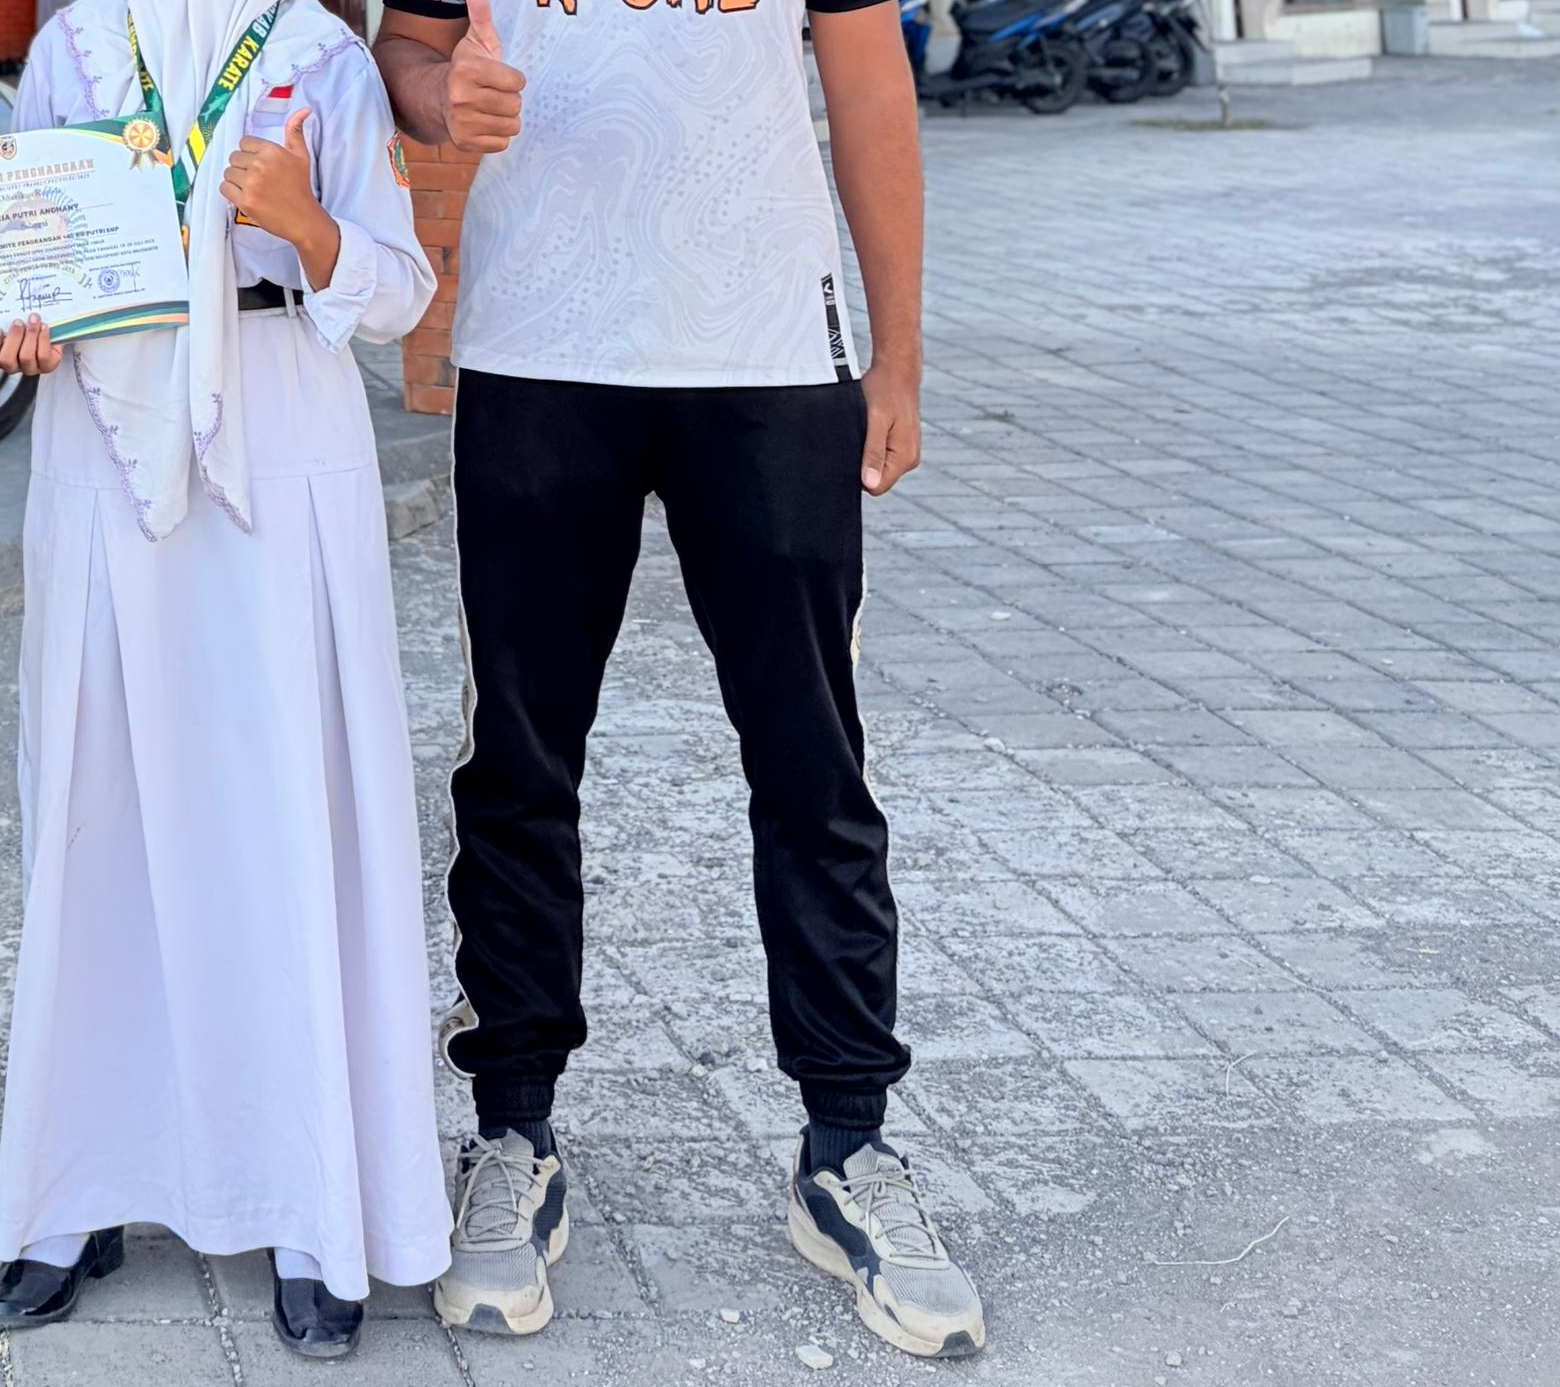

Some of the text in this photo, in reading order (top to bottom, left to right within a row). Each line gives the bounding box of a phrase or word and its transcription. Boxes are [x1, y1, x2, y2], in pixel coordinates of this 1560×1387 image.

[218, 35, 260, 91] KARATE
[7, 158, 95, 182] PENGHARGAAN
[12, 210, 37, 220] PUTRI
